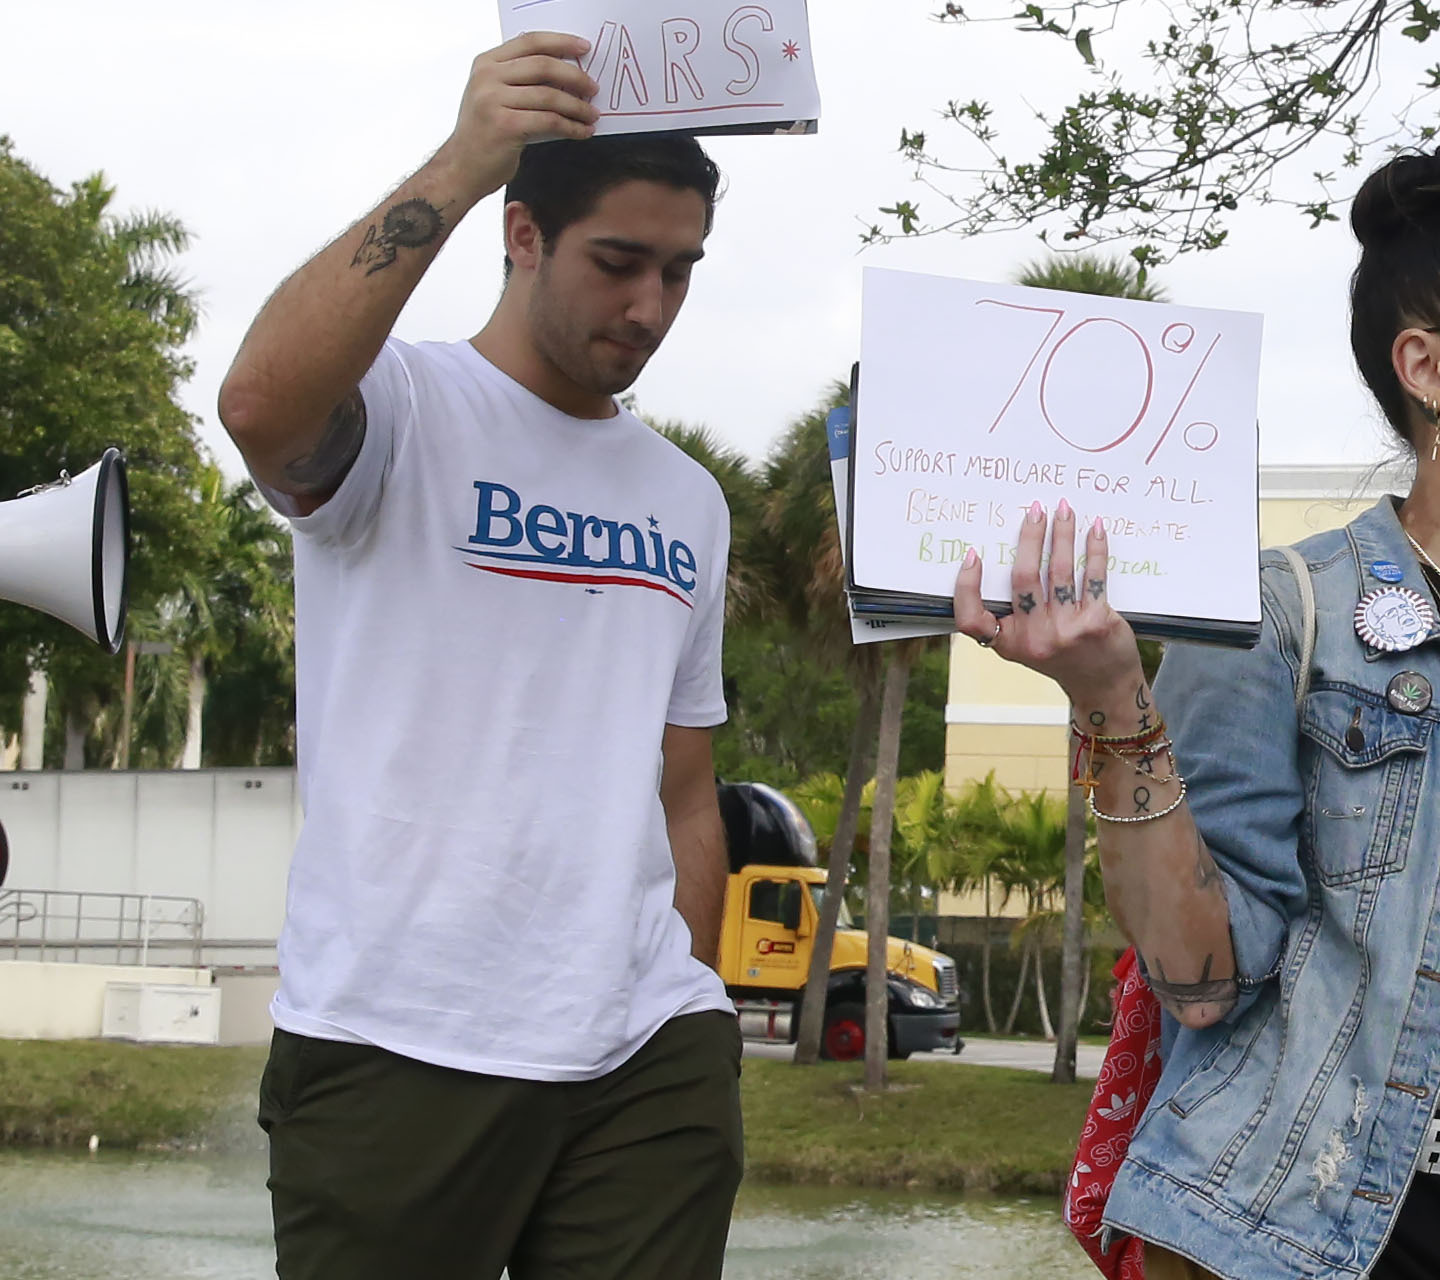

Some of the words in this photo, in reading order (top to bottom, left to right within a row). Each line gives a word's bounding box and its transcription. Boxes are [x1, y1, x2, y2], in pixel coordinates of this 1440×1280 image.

[976, 300, 1221, 465] 70%
[874, 440, 956, 476] SUPPORT
[963, 454, 1066, 487] MEDICARE
[1077, 468, 1130, 495] FOR
[1144, 476, 1214, 504] ALL.
[468, 480, 697, 591] Bernie
[906, 488, 978, 525] BERNIE
[988, 500, 1005, 528] IS
[1076, 554, 1168, 576] RDICAL.
